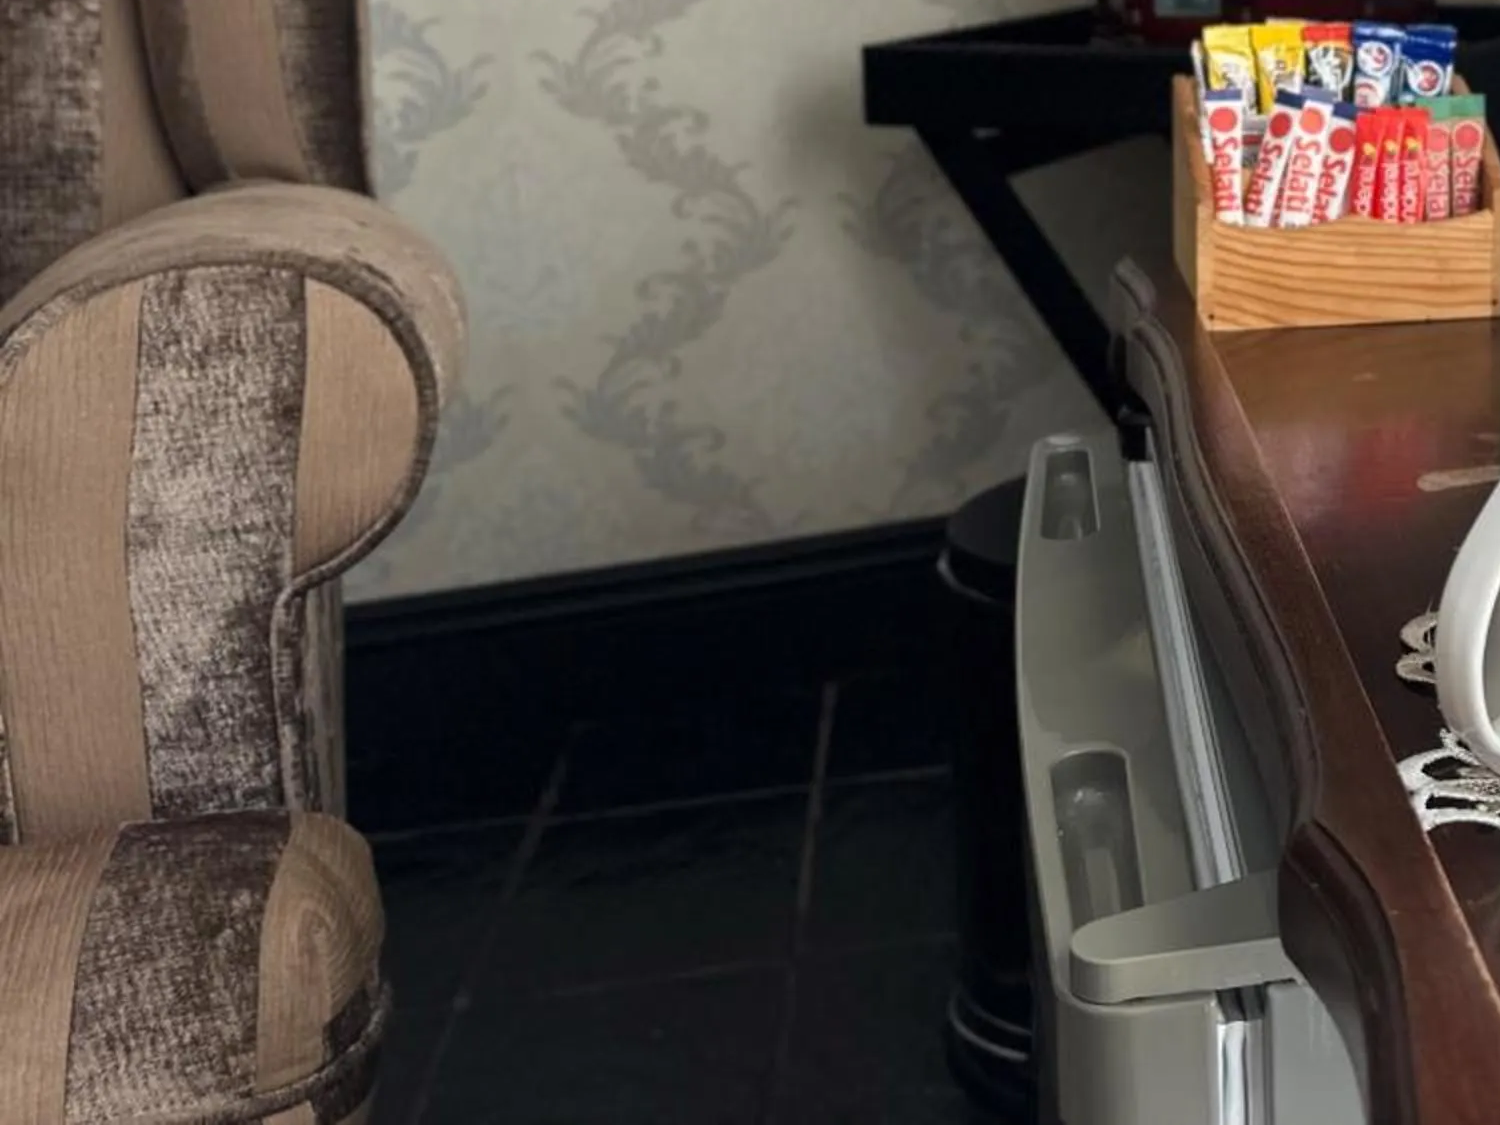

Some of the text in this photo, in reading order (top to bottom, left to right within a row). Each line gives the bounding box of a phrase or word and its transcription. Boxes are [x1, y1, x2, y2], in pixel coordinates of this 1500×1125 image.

[1212, 137, 1239, 211] Selati
[1243, 141, 1283, 216] Selati
[1286, 136, 1321, 212] Selati
[1312, 154, 1346, 223] Selat
[1427, 158, 1449, 215] Sela
[1455, 155, 1478, 211] Sela
